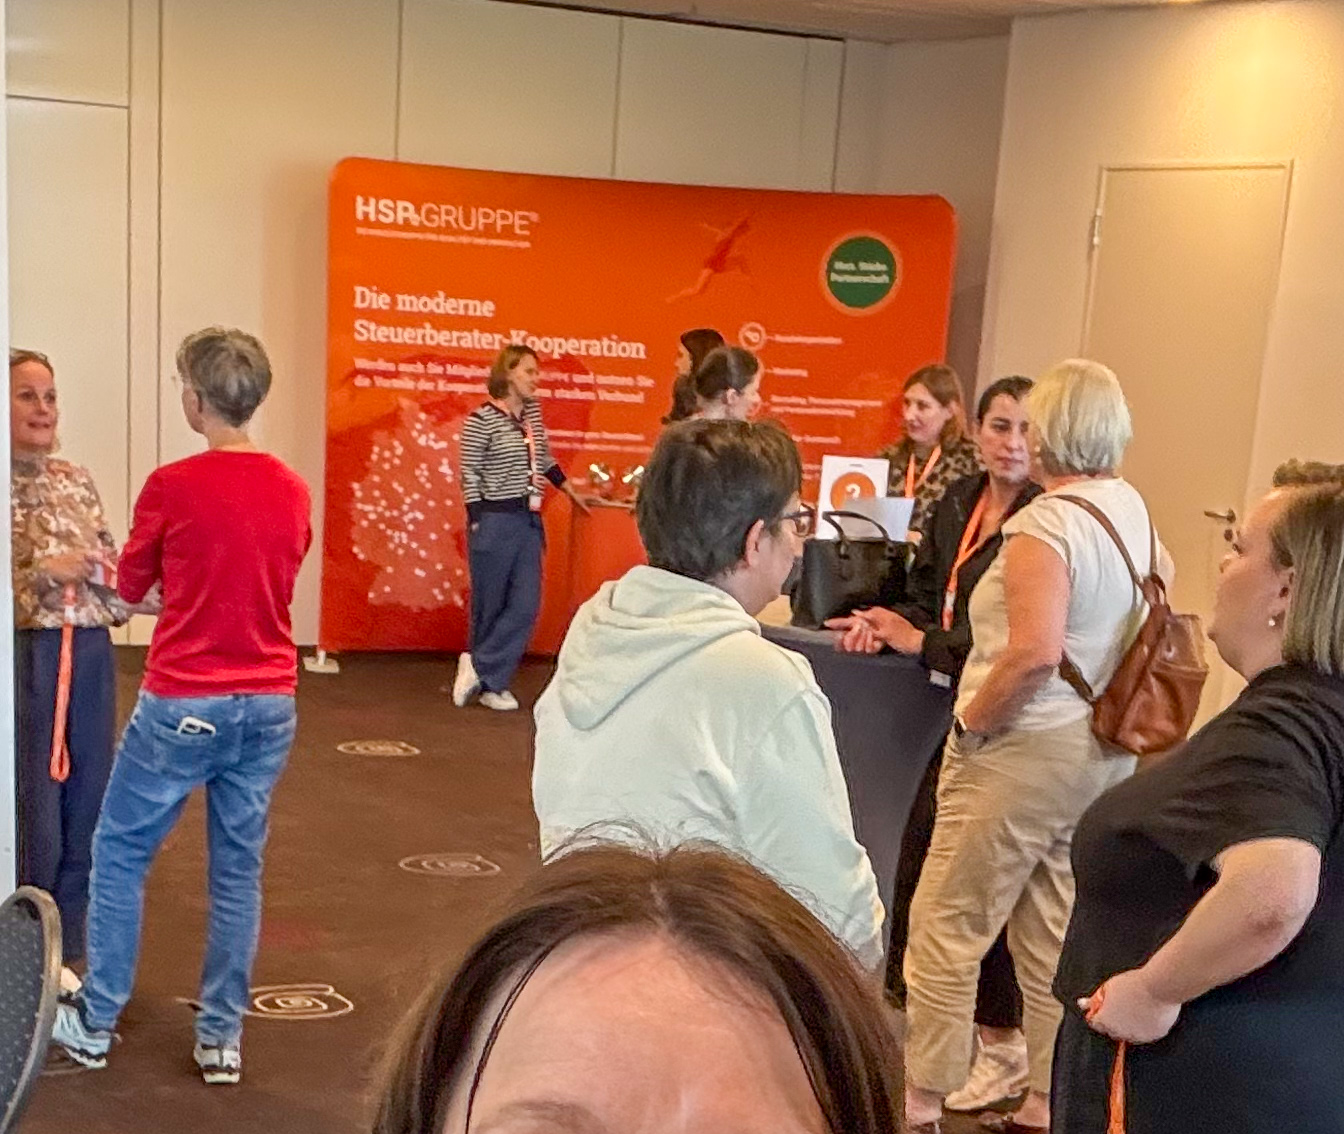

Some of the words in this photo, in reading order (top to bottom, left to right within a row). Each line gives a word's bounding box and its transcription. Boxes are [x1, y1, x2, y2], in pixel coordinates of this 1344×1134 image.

[354, 285, 391, 310] Die
[396, 290, 495, 317] moderne
[354, 319, 646, 359] Steuerberater-Kooperation
